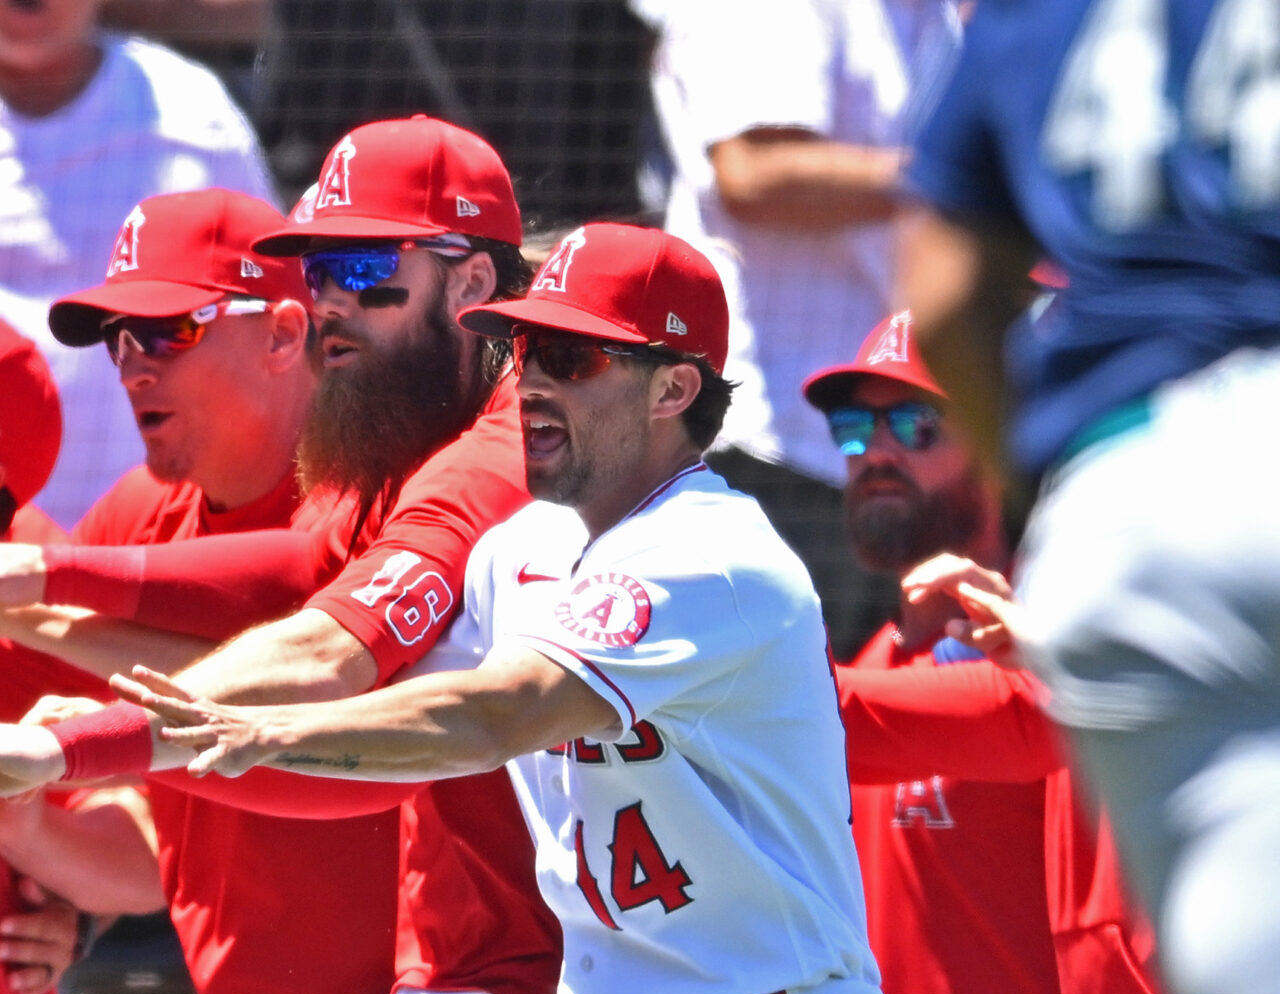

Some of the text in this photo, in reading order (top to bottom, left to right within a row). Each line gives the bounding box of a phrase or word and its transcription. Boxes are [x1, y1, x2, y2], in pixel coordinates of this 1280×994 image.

[316, 135, 356, 208] A
[107, 205, 146, 278] A
[531, 226, 586, 292] A
[867, 309, 912, 366] A
[351, 551, 453, 646] 16
